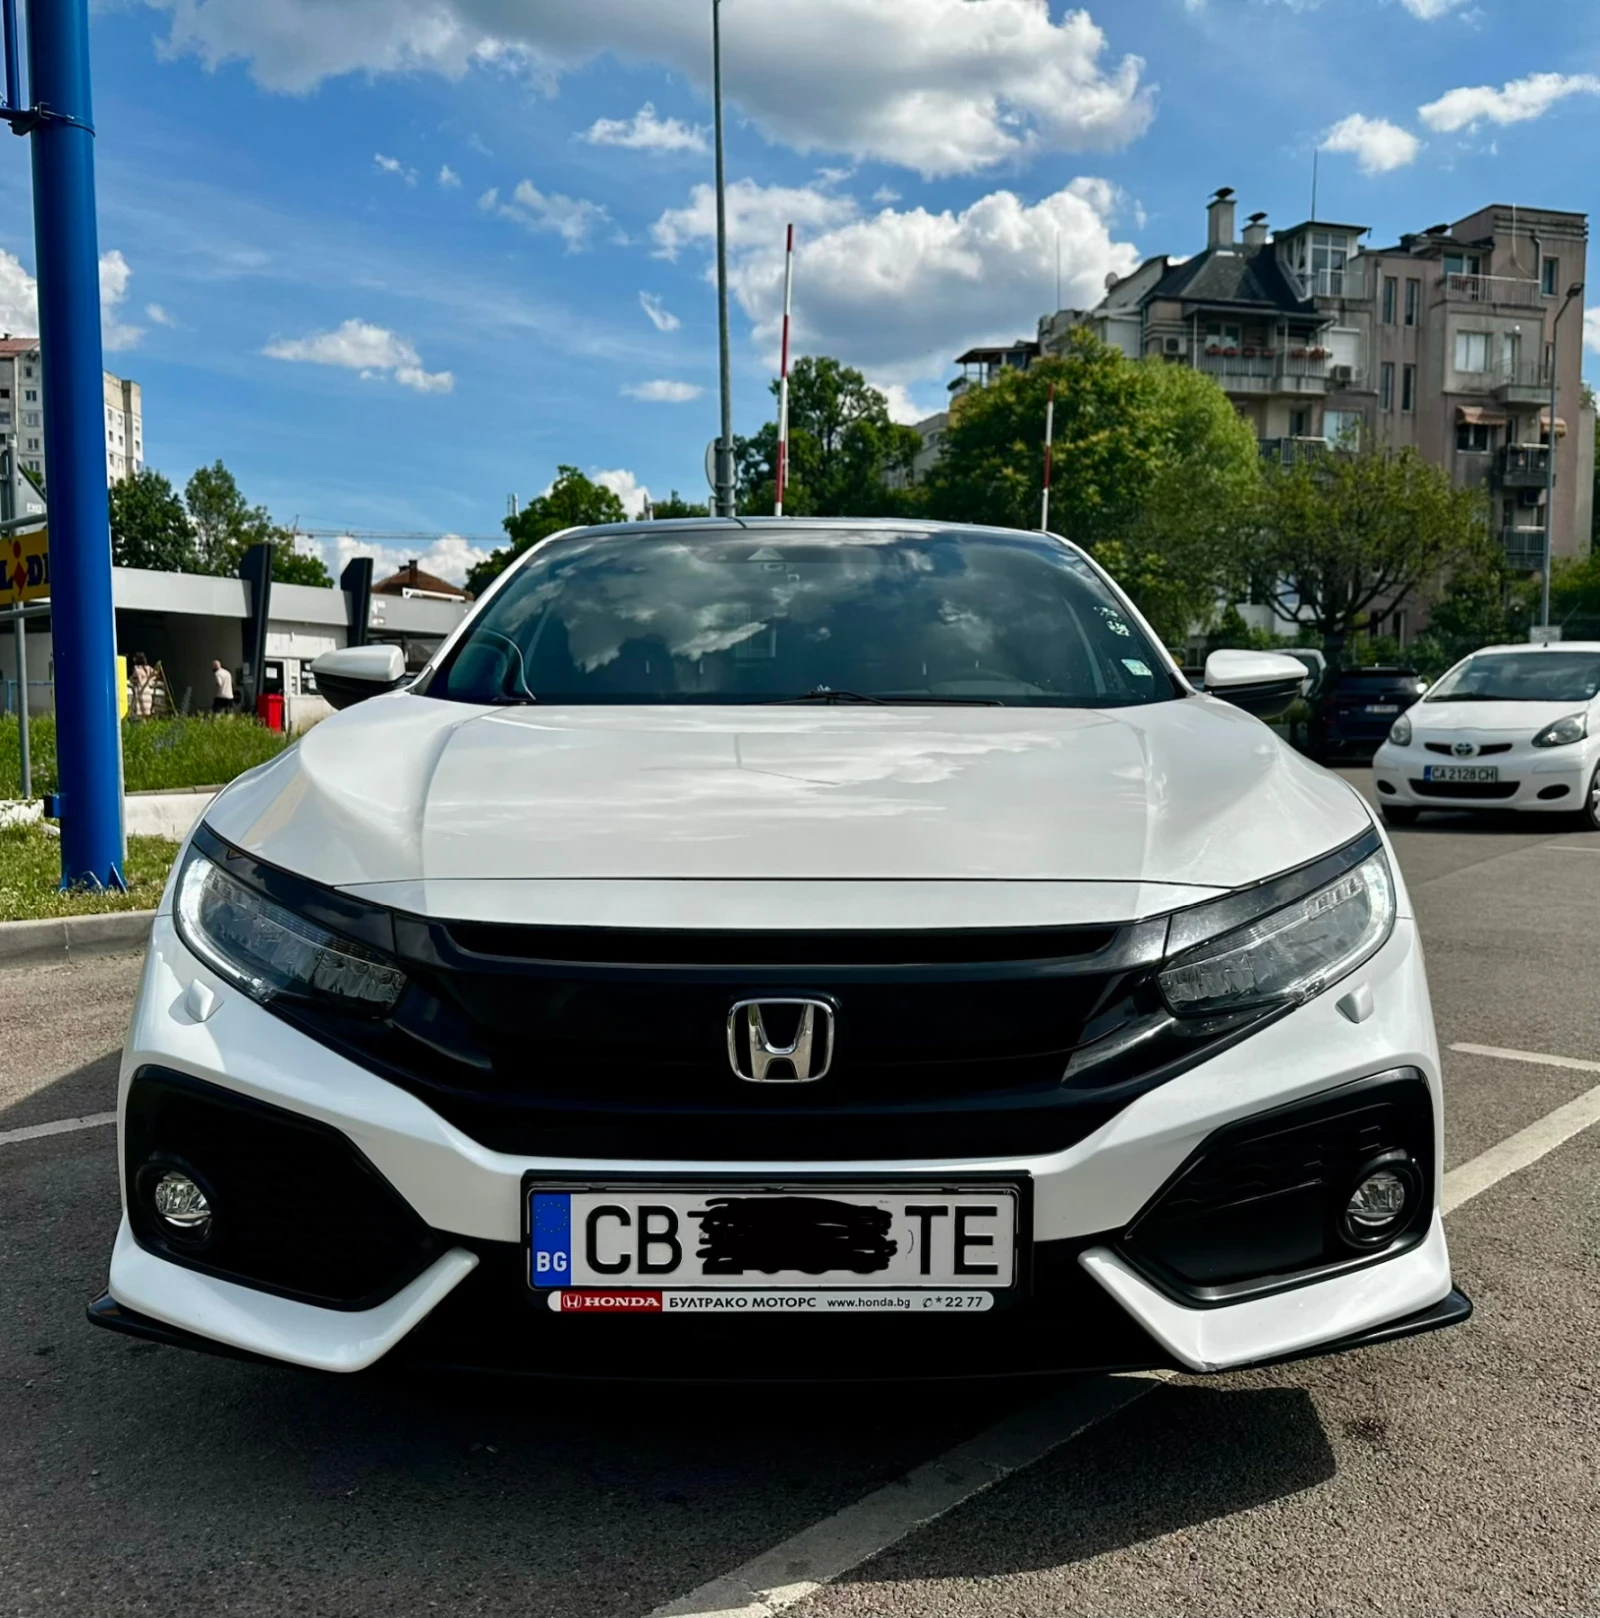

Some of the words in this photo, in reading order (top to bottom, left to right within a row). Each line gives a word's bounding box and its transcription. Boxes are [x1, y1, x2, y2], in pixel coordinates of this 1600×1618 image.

[1432, 768, 1446, 779] CA
[586, 1205, 682, 1275] CB
[904, 1205, 999, 1275] TE
[536, 1252, 567, 1272] BG
[584, 1297, 660, 1307] HONDA
[669, 1297, 748, 1308] БУЛТРАКО
[752, 1297, 817, 1308] МОТОРС
[827, 1297, 911, 1309] www.honda.bg
